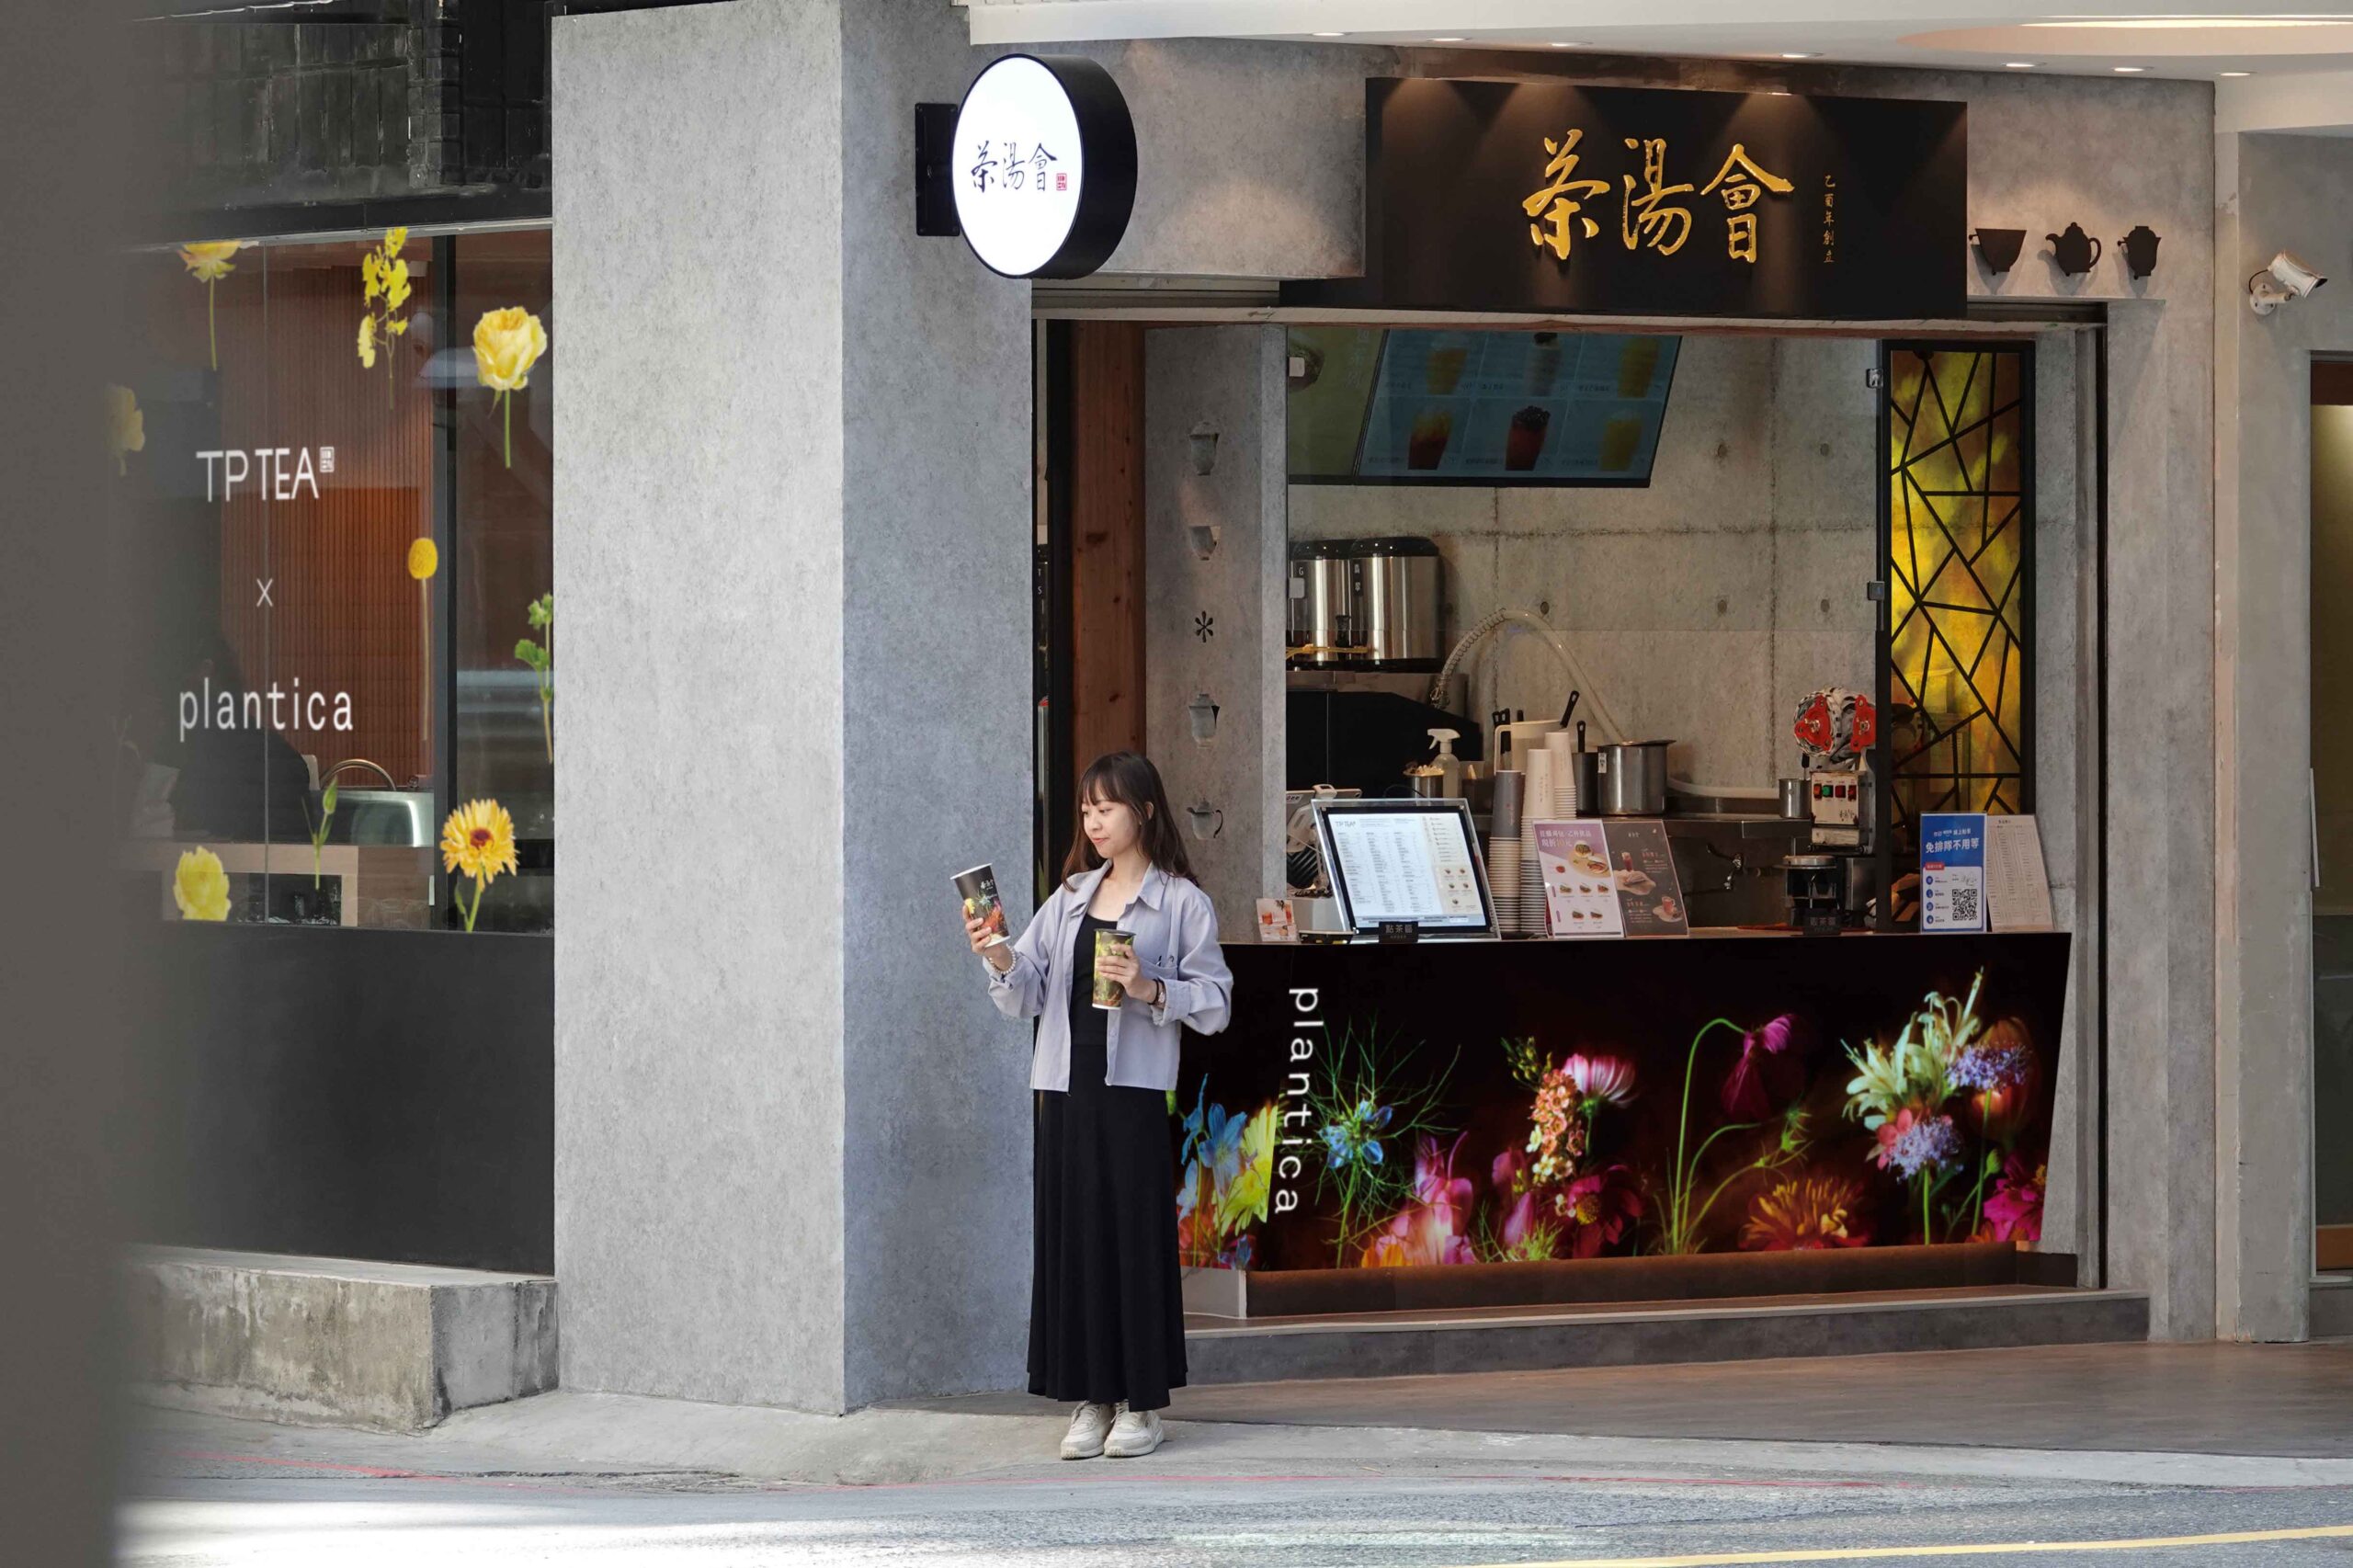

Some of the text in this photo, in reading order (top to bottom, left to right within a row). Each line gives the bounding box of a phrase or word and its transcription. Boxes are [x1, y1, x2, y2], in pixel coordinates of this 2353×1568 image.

[971, 140, 1058, 193] 茶湯會
[1522, 129, 1795, 263] 茶湯會
[179, 676, 354, 743] plantica
[1926, 837, 1980, 854] 免排隊不用等
[1275, 988, 1324, 1214] plantica
